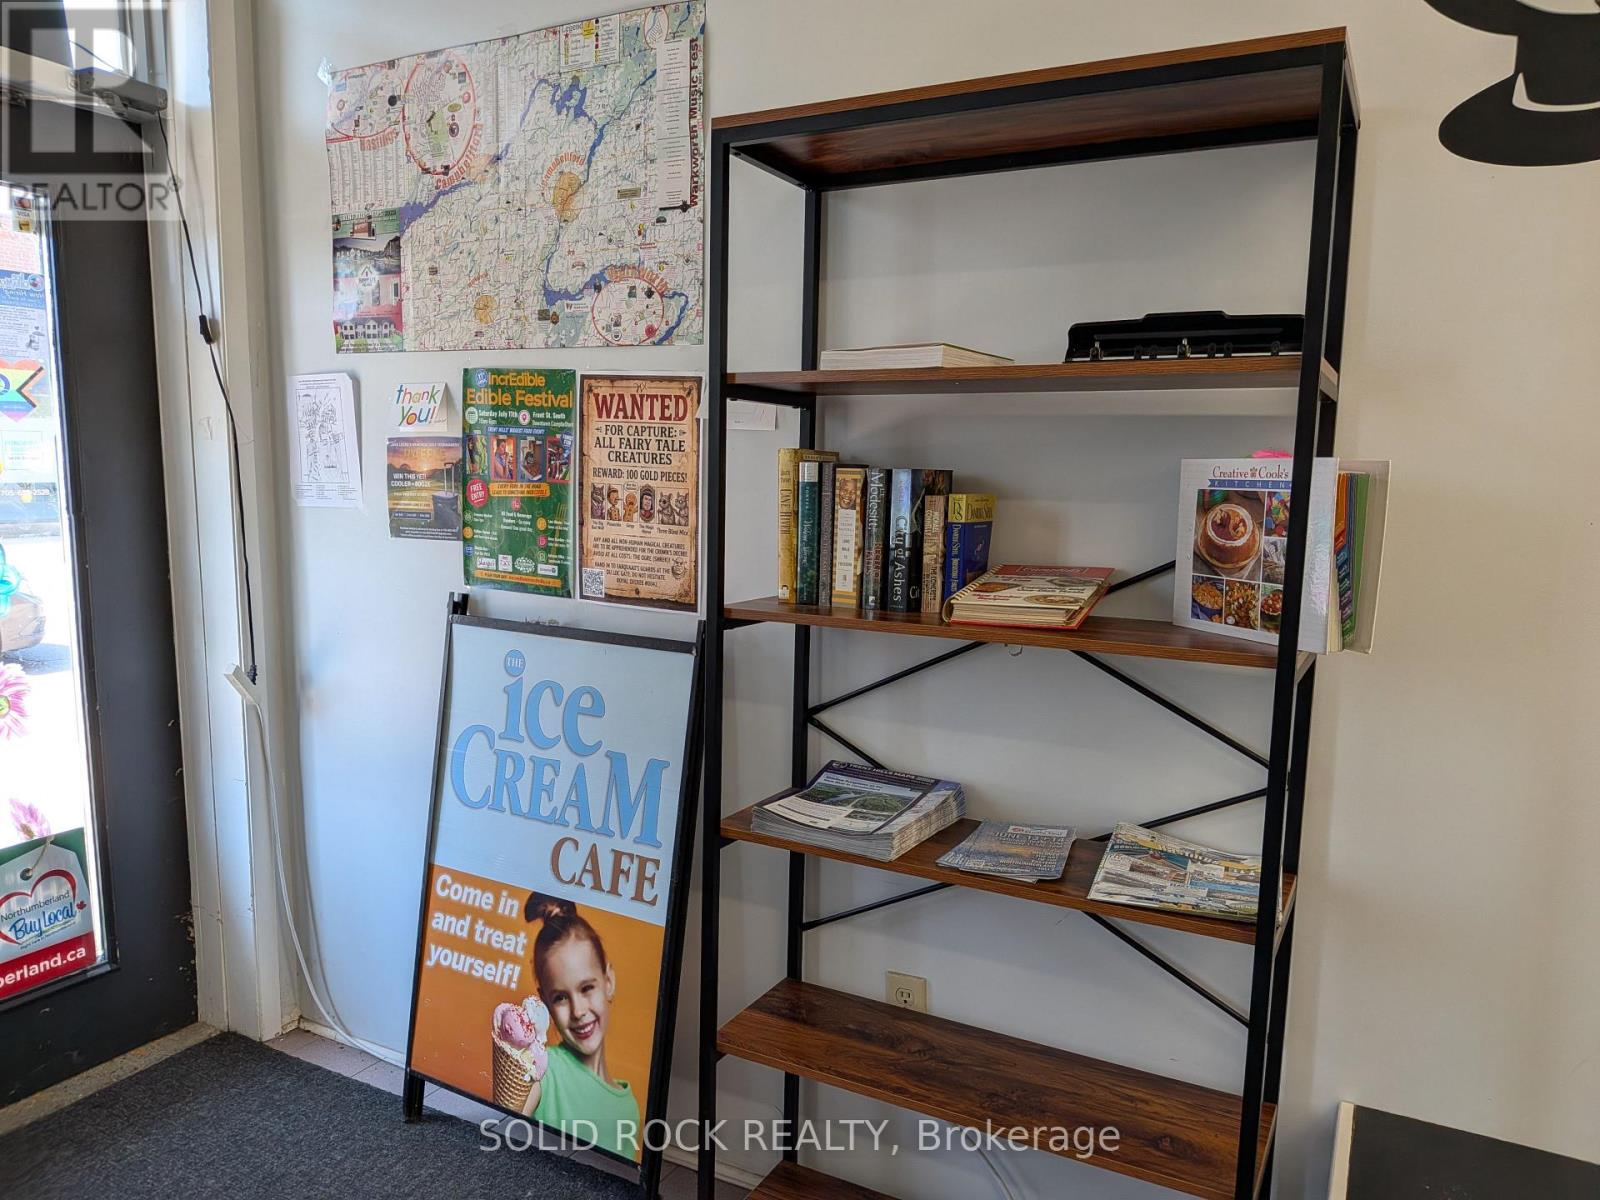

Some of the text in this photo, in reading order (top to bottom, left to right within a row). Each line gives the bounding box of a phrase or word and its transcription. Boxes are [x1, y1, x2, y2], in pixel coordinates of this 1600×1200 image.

[690, 37, 699, 207] Warkworth Music Fest
[488, 372, 546, 386] IncrEdible
[396, 384, 440, 405] thank
[466, 388, 573, 408] Edible Festival
[398, 406, 436, 426] you!
[592, 393, 688, 422] WANTED
[605, 424, 677, 438] FOR CAPTURE:
[594, 436, 686, 452] ALL FAIRY TALE
[608, 450, 672, 465] CREATURES
[593, 467, 687, 483] REWARD: 100 GOLD PIECES!
[1213, 464, 1288, 479] Creative Cook's
[470, 483, 482, 492] FREE
[471, 490, 485, 500] ENTRY
[1214, 481, 1285, 489] KITCHEN
[895, 516, 907, 546] City
[895, 548, 905, 560] of
[893, 561, 906, 601] Ashes
[506, 658, 524, 669] THE
[499, 650, 606, 757] ice
[450, 724, 670, 848] CREAM
[551, 836, 660, 906] CAFE
[1, 890, 70, 921] Northumberland
[436, 874, 519, 918] Come in
[9, 917, 43, 940] Buy
[42, 901, 77, 928] Local
[431, 910, 528, 956] and treat
[426, 943, 522, 990] yourself!
